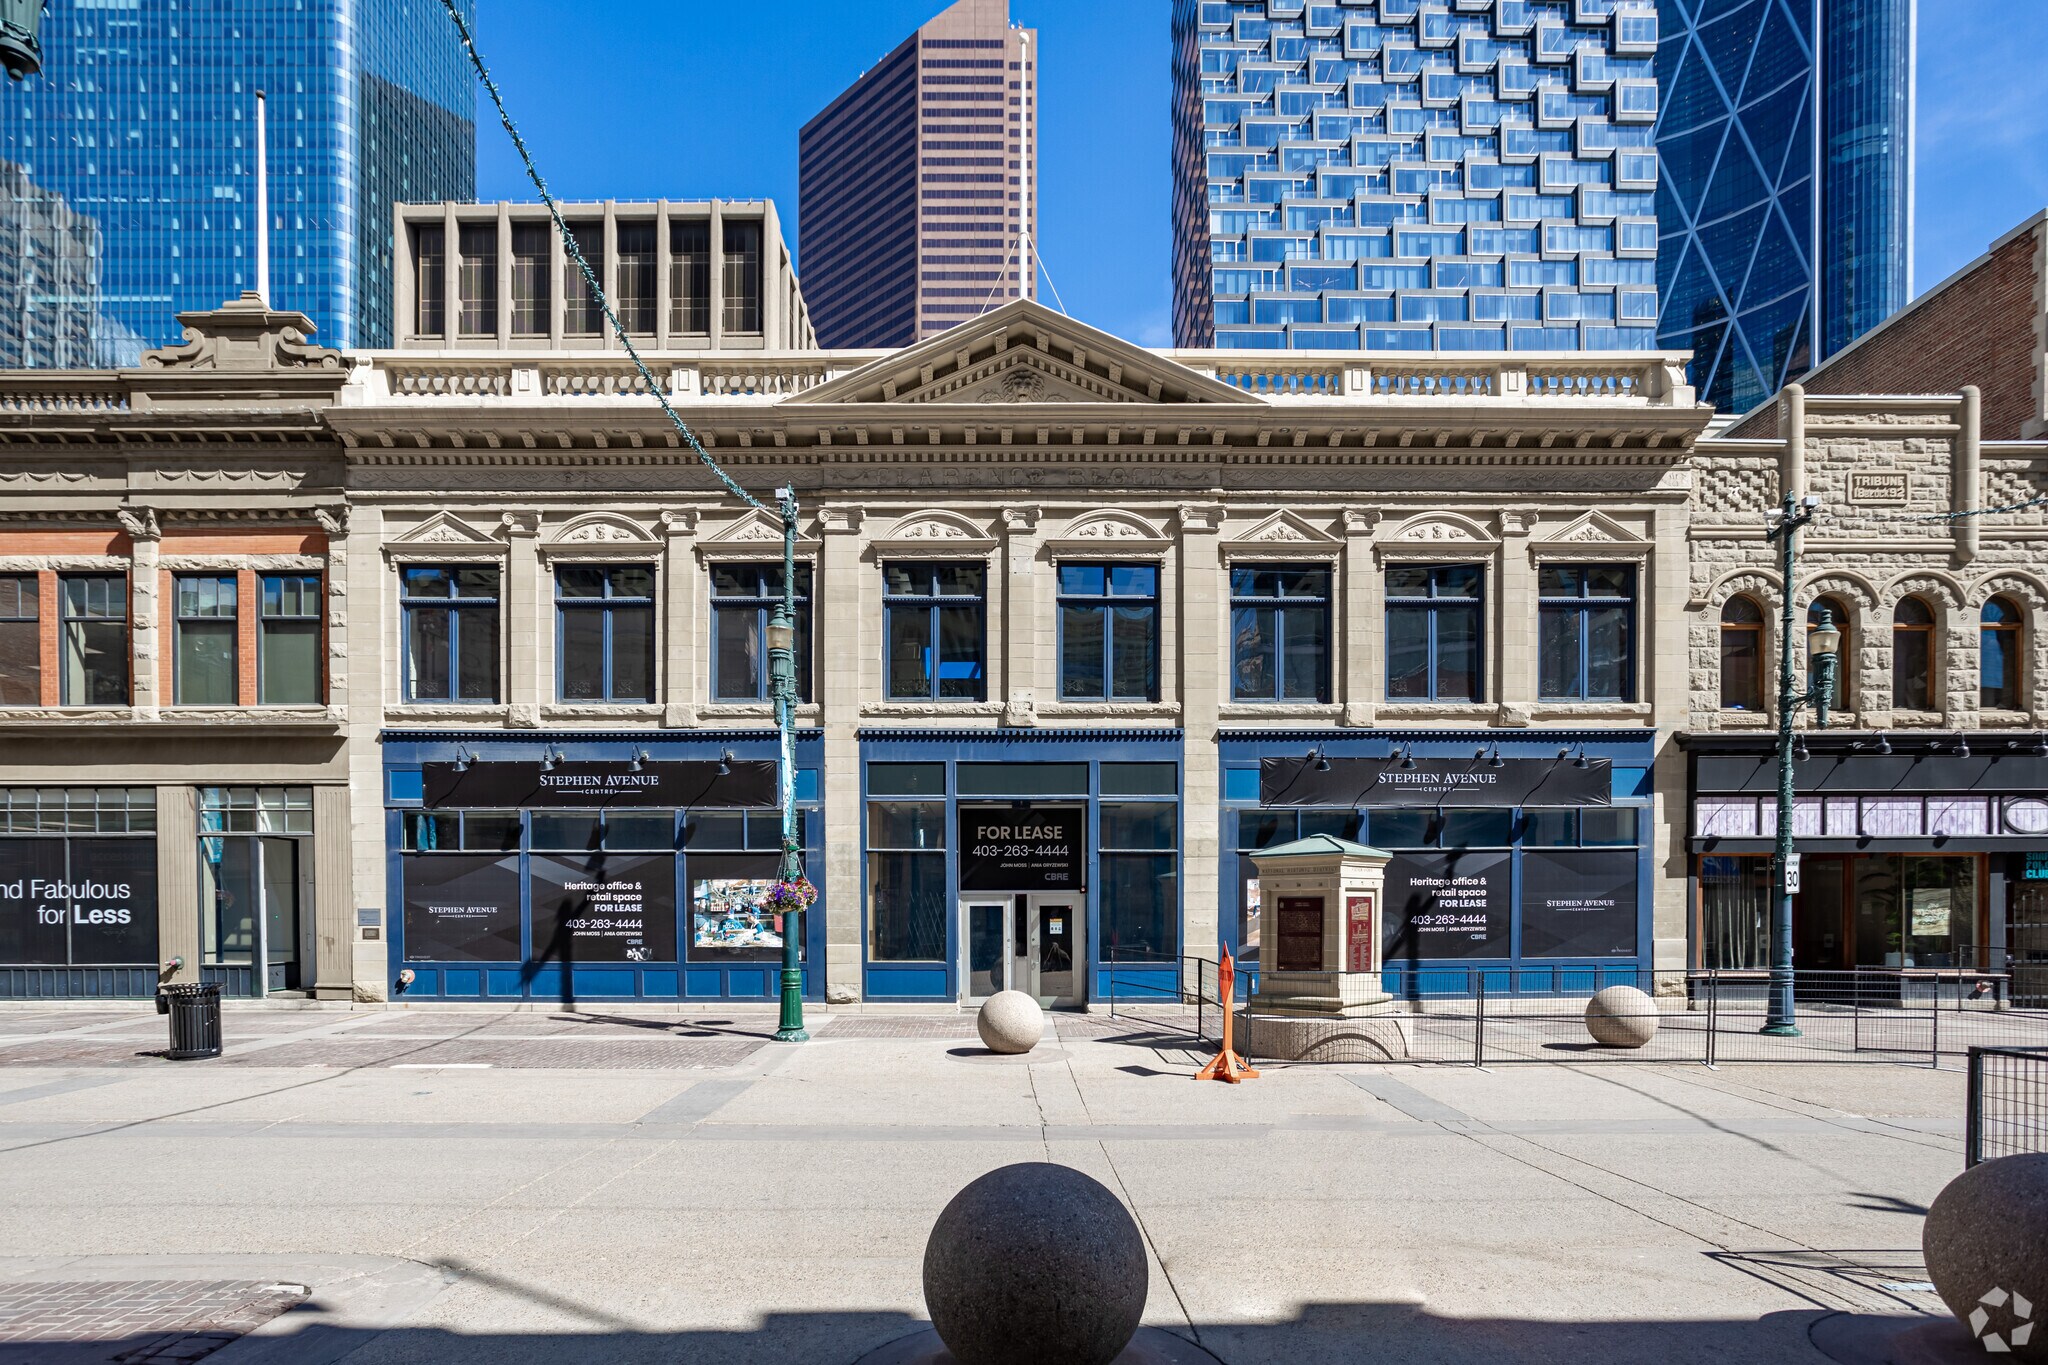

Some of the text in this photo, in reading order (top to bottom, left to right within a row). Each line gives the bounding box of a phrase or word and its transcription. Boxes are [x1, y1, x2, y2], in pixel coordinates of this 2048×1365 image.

[875, 467, 1166, 485] CLARENCE BLOCK
[1854, 475, 1905, 486] TRIBUNE
[539, 774, 659, 787] STEPHEN AVENUE
[1378, 772, 1497, 784] STEPHEN AVENUE
[977, 825, 1063, 840] FOR LEASE
[972, 844, 1069, 857] 403-263-4444
[1044, 872, 1069, 881] CBRE
[1786, 871, 1798, 887] 30
[564, 881, 642, 892] Heritage office &
[1410, 877, 1487, 888] Heritage office &
[31, 879, 131, 899] Fabulous
[1431, 888, 1487, 898] retail space
[586, 892, 642, 903] retail space
[1546, 899, 1615, 907] STEPHEN AVENUE
[594, 904, 642, 912] FOR LEASE
[1439, 899, 1487, 908] FOR LEASE
[37, 904, 132, 924] for Less
[1410, 914, 1487, 924] 403-263-4444
[565, 919, 643, 929] 403-263-4444
